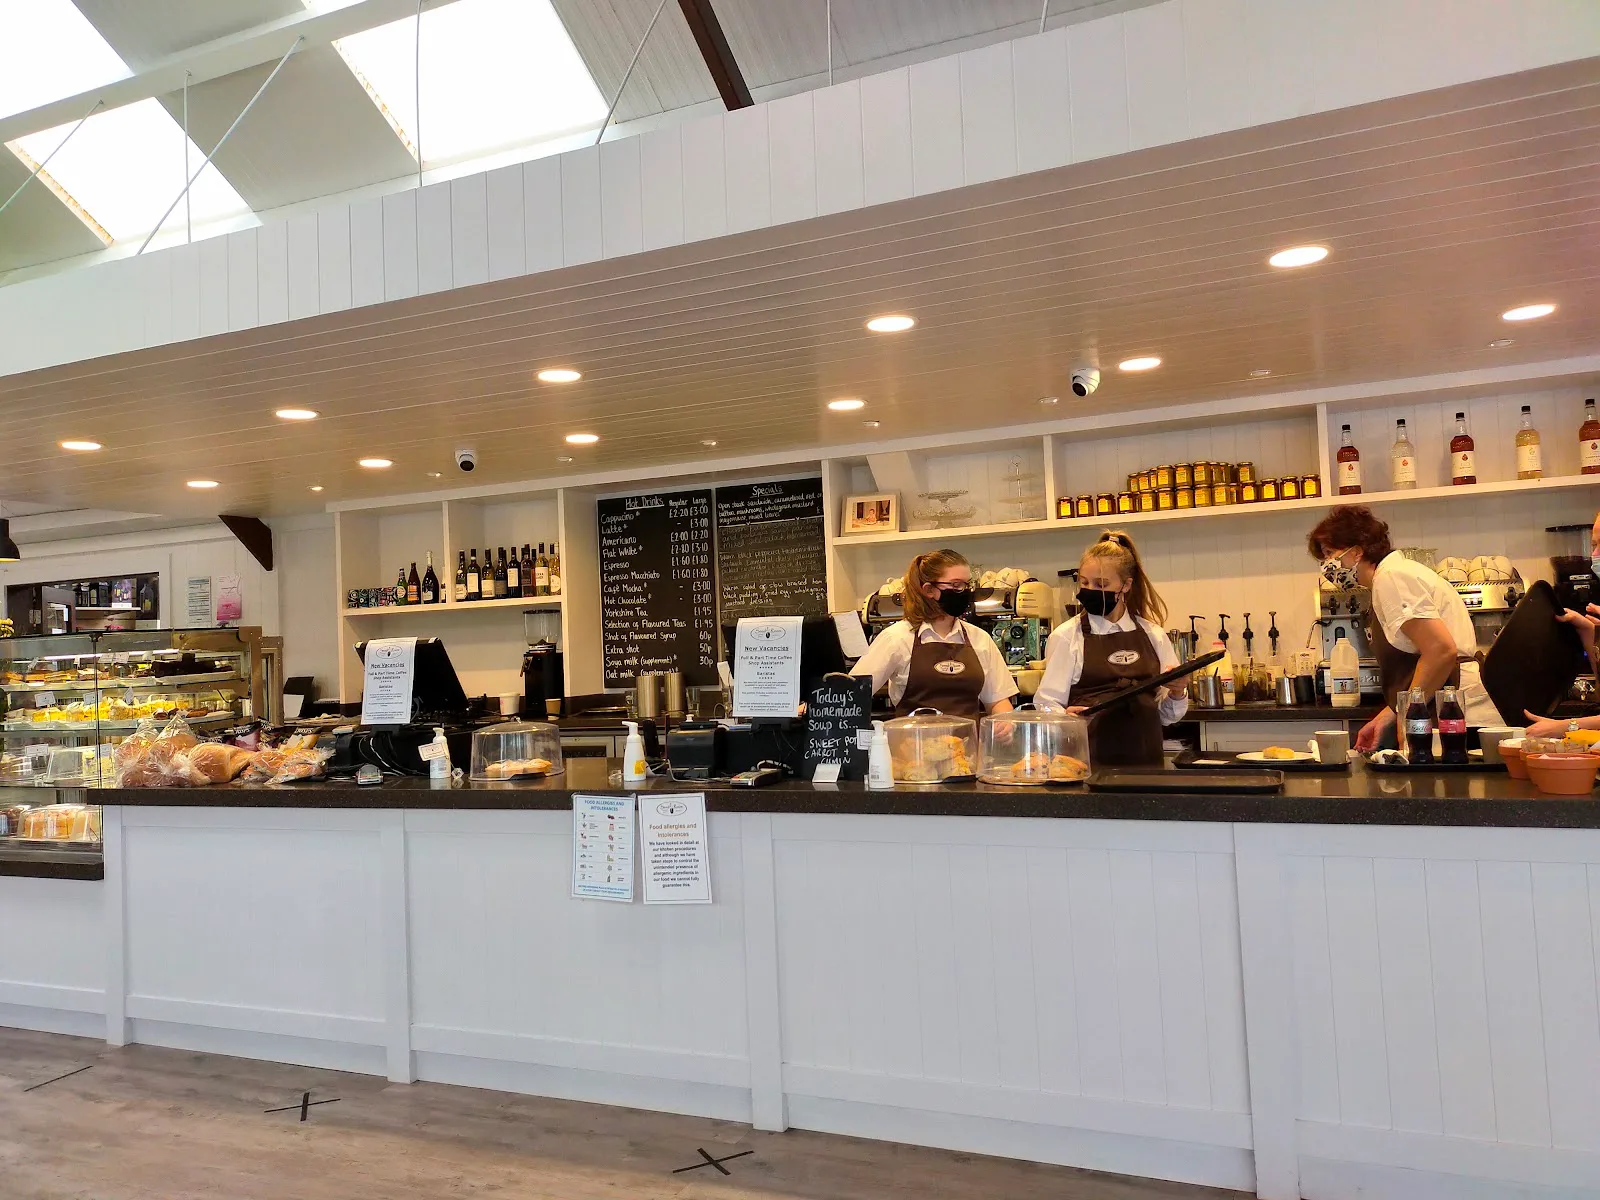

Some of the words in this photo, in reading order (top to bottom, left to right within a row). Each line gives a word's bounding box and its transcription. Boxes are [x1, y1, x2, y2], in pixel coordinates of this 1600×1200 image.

[752, 485, 782, 497] Specials
[625, 498, 638, 507] Hot
[642, 496, 664, 506] Drinks
[669, 499, 688, 507] Regular
[693, 497, 707, 508] Large
[601, 525, 623, 534] Latte
[602, 536, 636, 546] Americano
[603, 549, 616, 558] Flat
[618, 547, 637, 556] White
[603, 561, 630, 571] Espresso
[604, 573, 628, 582] Espresso
[631, 571, 660, 580] Macchiato
[622, 584, 643, 592] Mocha
[604, 597, 616, 605] Hot
[618, 596, 647, 605] Chocolate
[604, 608, 633, 617] Yorkshire
[635, 607, 648, 616] Tea
[604, 620, 630, 629] Selection
[633, 621, 639, 629] of
[641, 619, 670, 628] Flavoured
[672, 619, 687, 627] Teas
[604, 632, 619, 641] Shot
[621, 634, 628, 642] of
[630, 631, 657, 640] Flavoured
[660, 632, 677, 641] Syrup
[699, 631, 712, 641] 60p
[605, 645, 624, 654] Extra
[626, 644, 640, 653] shot
[699, 643, 712, 654] 50p
[605, 657, 622, 668] Soya
[624, 656, 639, 666] milk
[699, 656, 714, 667] 30p
[605, 669, 618, 679] Oat
[620, 669, 635, 678] milk
[812, 688, 854, 707] Today's
[809, 703, 862, 718] homemade
[808, 719, 832, 736] Soup
[809, 737, 841, 748] SWEET
[805, 748, 838, 759] CARROT
